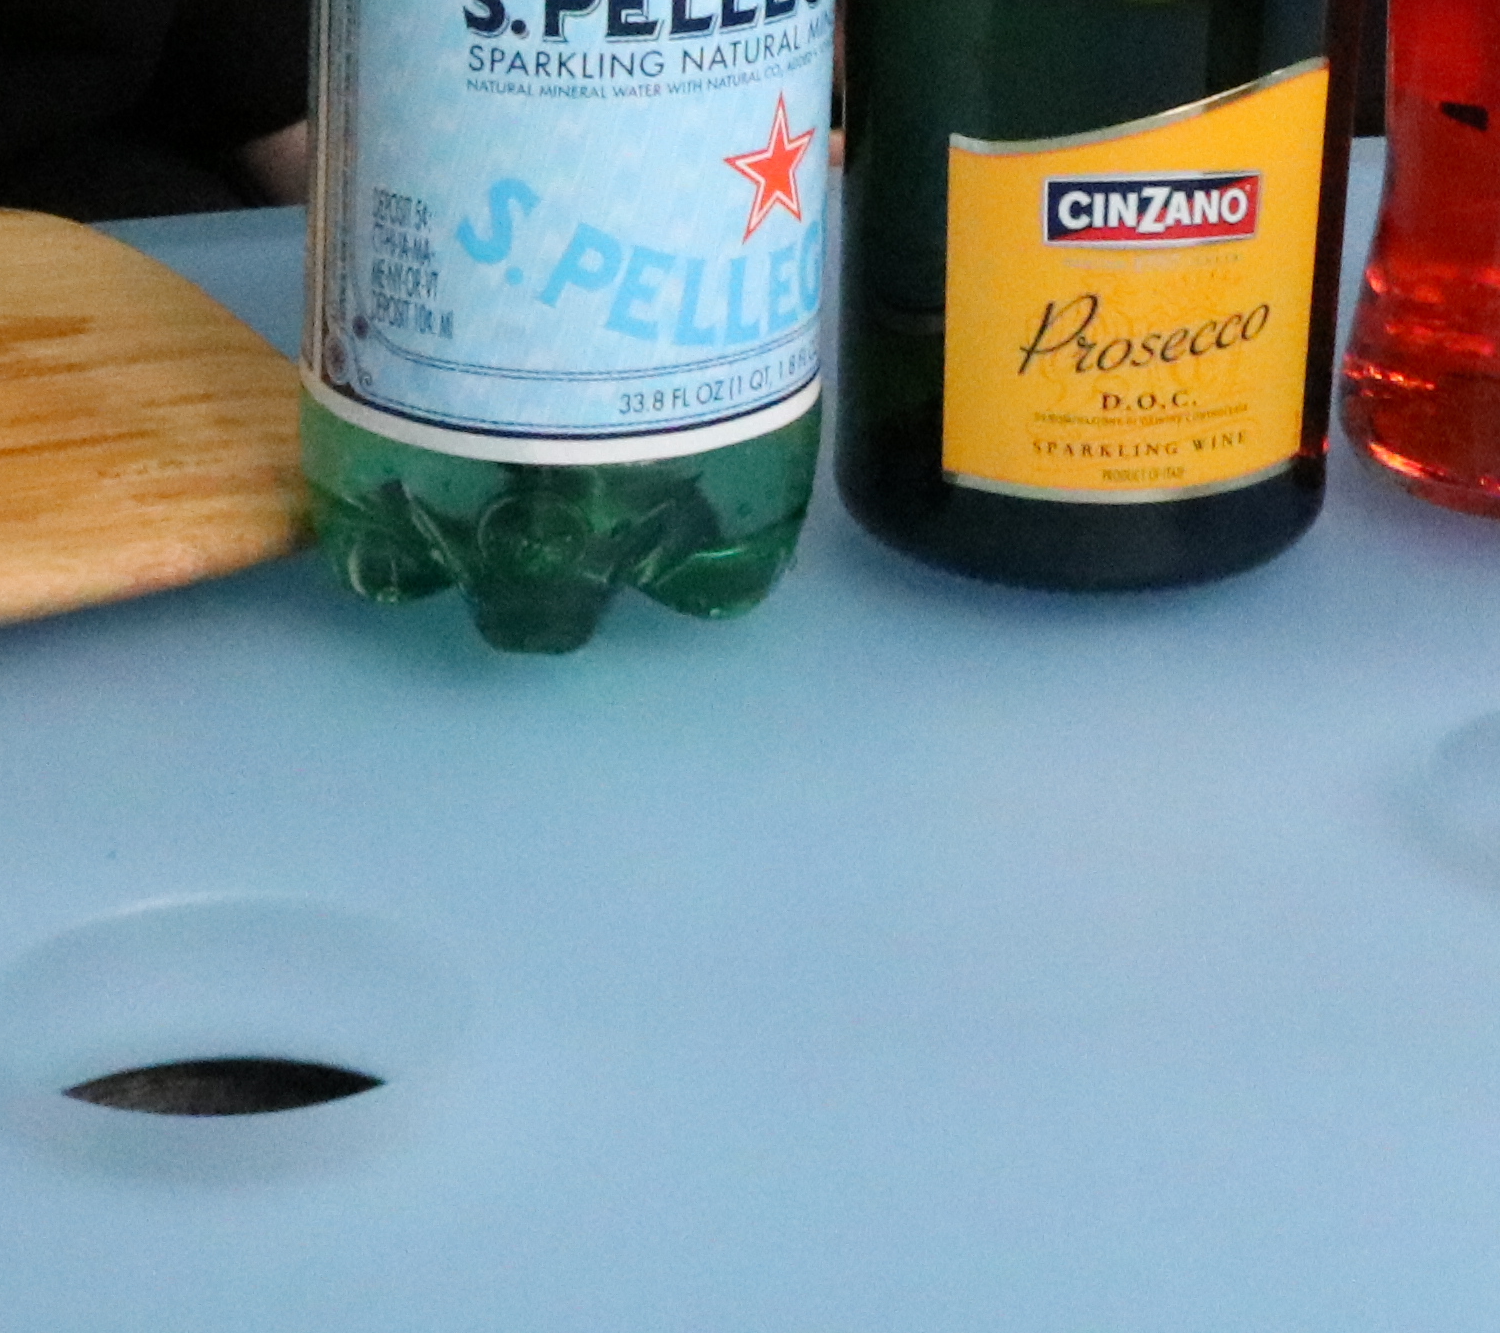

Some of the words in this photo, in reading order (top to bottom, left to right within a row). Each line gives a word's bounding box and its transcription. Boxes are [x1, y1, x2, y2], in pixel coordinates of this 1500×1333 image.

[467, 45, 665, 81] SPARKLING
[681, 24, 801, 75] NATURAL
[467, 78, 534, 98] NATURAL
[538, 82, 609, 101] MINERAL
[610, 82, 662, 100] WATER
[667, 80, 703, 96] WITH
[706, 71, 761, 94] NATURAL
[1057, 186, 1248, 234] CINZANO
[1017, 292, 1270, 376] Prosecco
[619, 389, 665, 415] 33.8
[672, 387, 691, 409] FL
[696, 380, 725, 405] OZ
[1101, 389, 1198, 411] D.O.C.
[1032, 438, 1179, 459] SPARKLING
[1192, 429, 1248, 454] WINE
